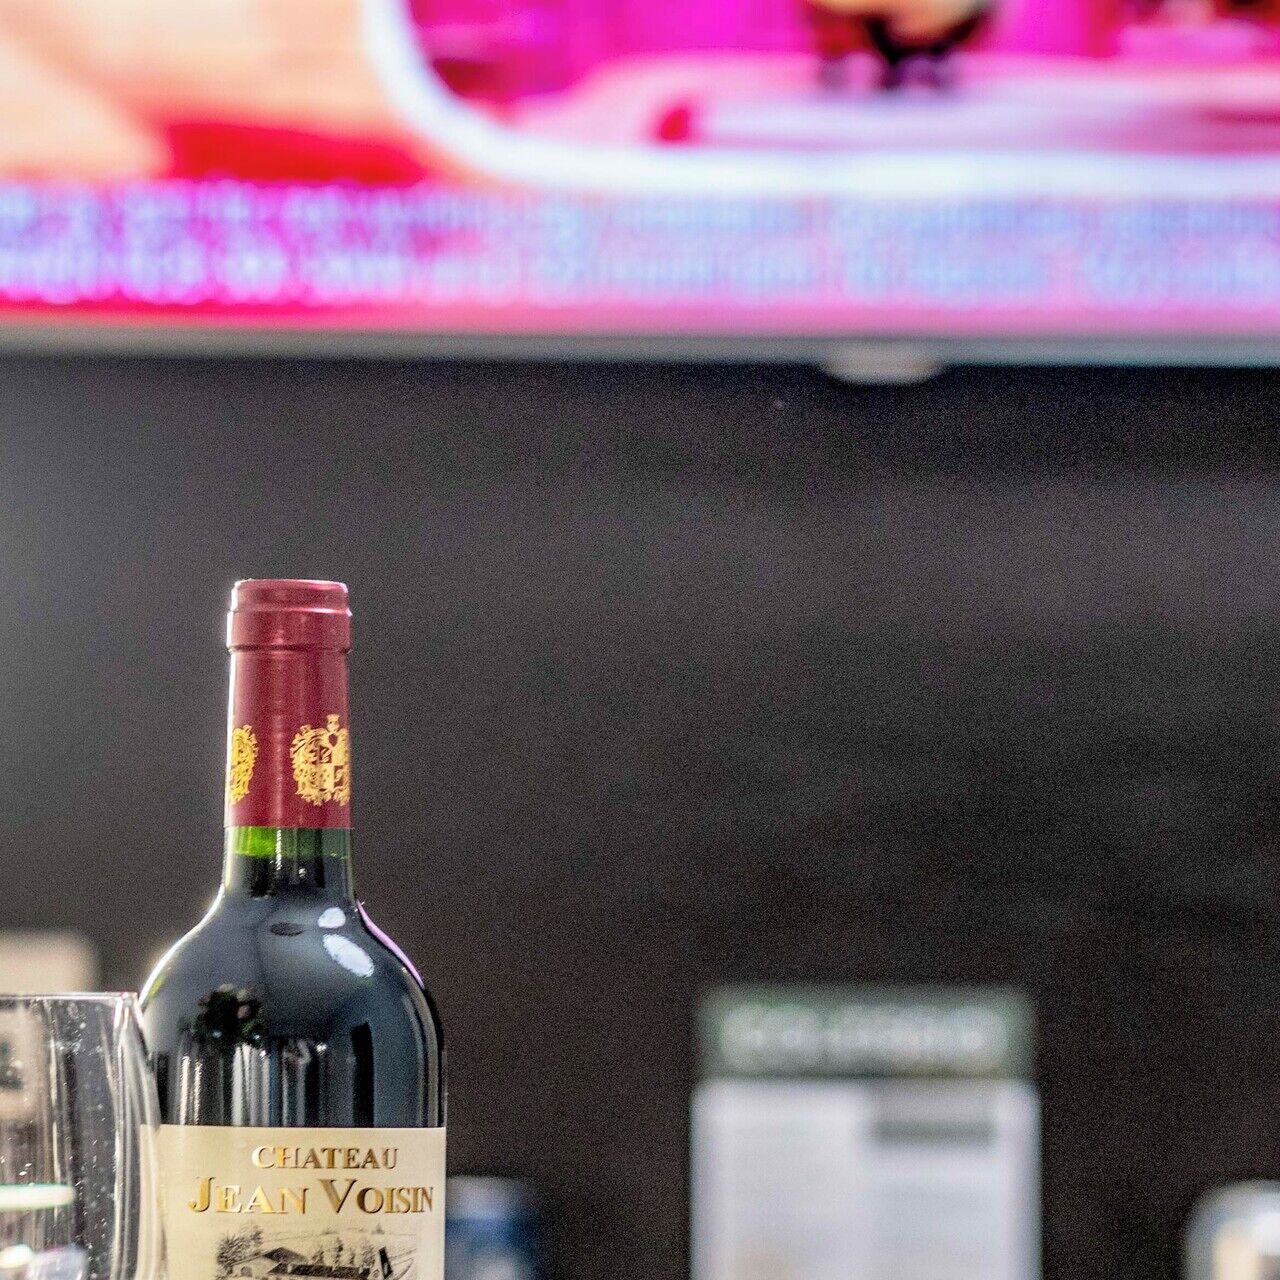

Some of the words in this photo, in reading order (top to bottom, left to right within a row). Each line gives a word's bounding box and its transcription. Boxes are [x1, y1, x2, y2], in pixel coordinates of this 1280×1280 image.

[251, 1146, 399, 1169] CHATEAU
[188, 1176, 309, 1214] JEAN
[317, 1178, 434, 1214] VOISIN
